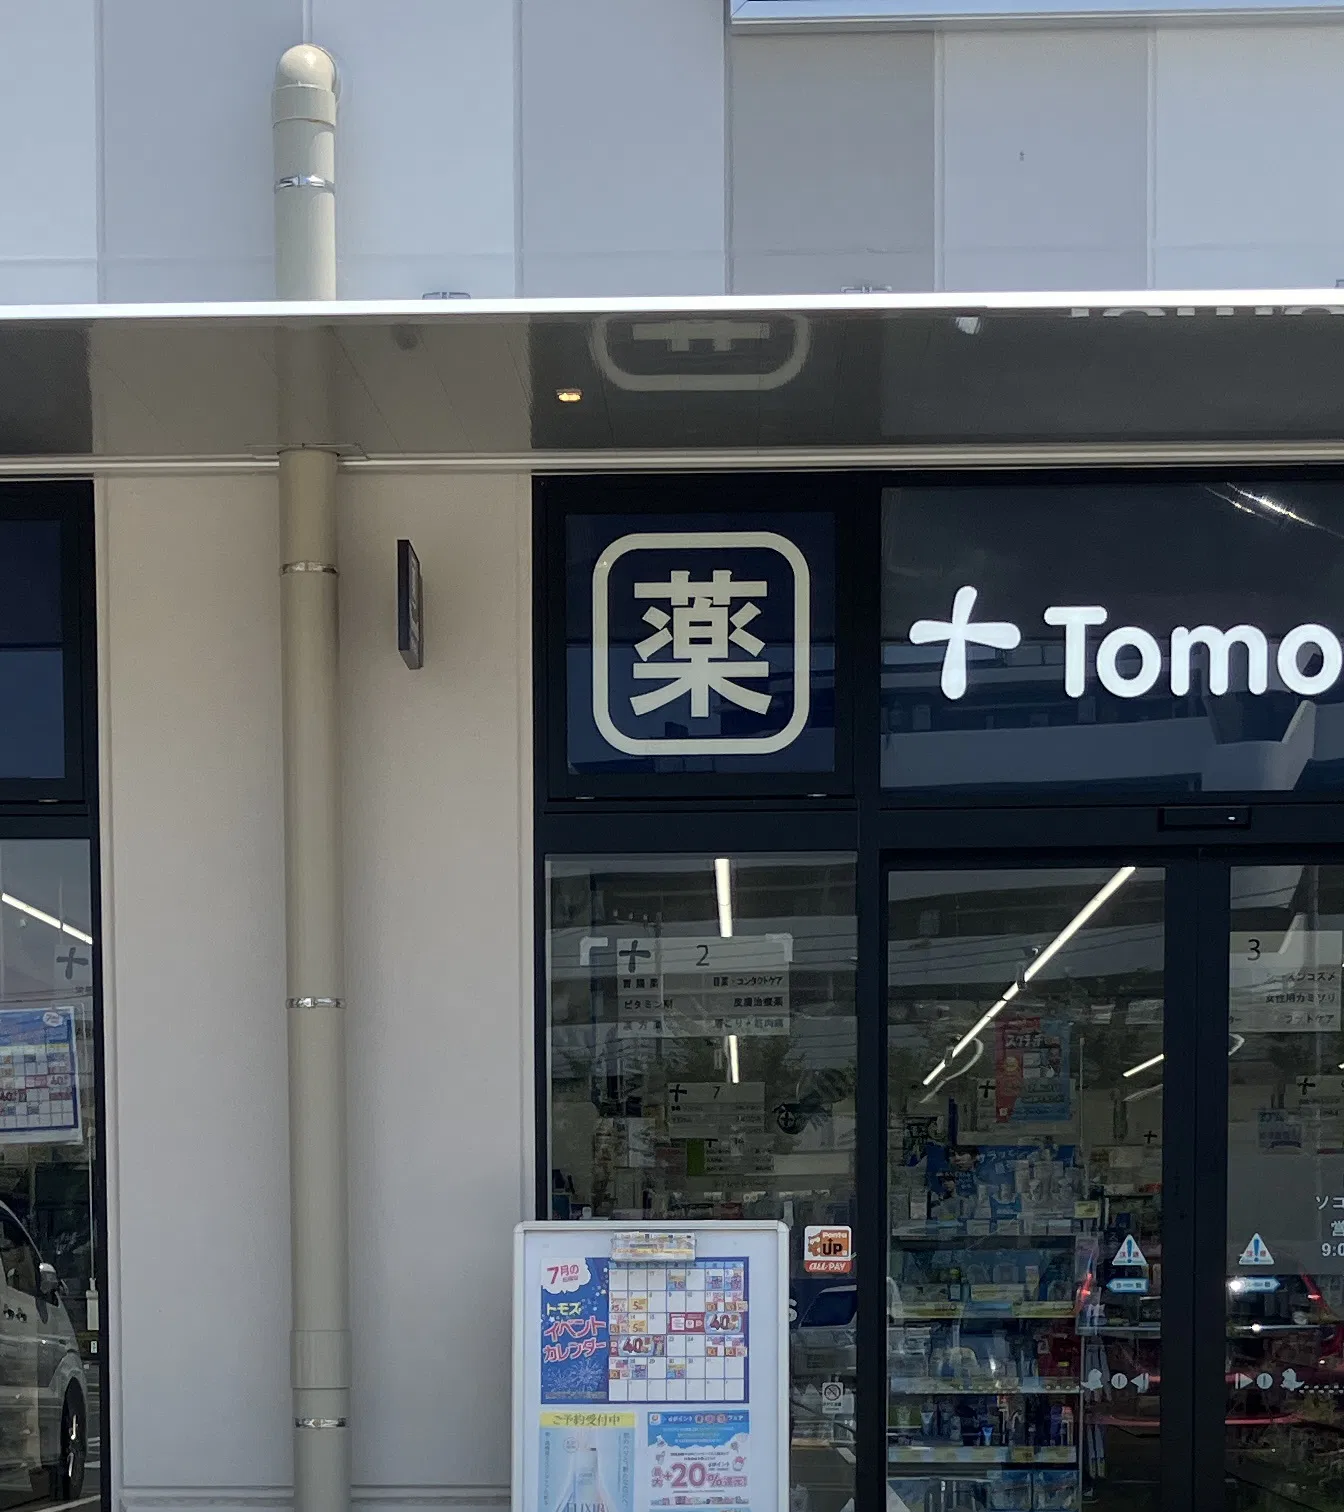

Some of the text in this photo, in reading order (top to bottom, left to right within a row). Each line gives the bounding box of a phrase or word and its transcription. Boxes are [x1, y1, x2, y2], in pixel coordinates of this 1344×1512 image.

[632, 569, 772, 718] 薬
[696, 944, 710, 967] 2
[1247, 938, 1261, 961] 3
[547, 1302, 582, 1316] トモズ
[545, 1315, 606, 1342] イベント
[544, 1338, 606, 1363] カレンダー
[553, 1413, 621, 1427] ご予約受付中
